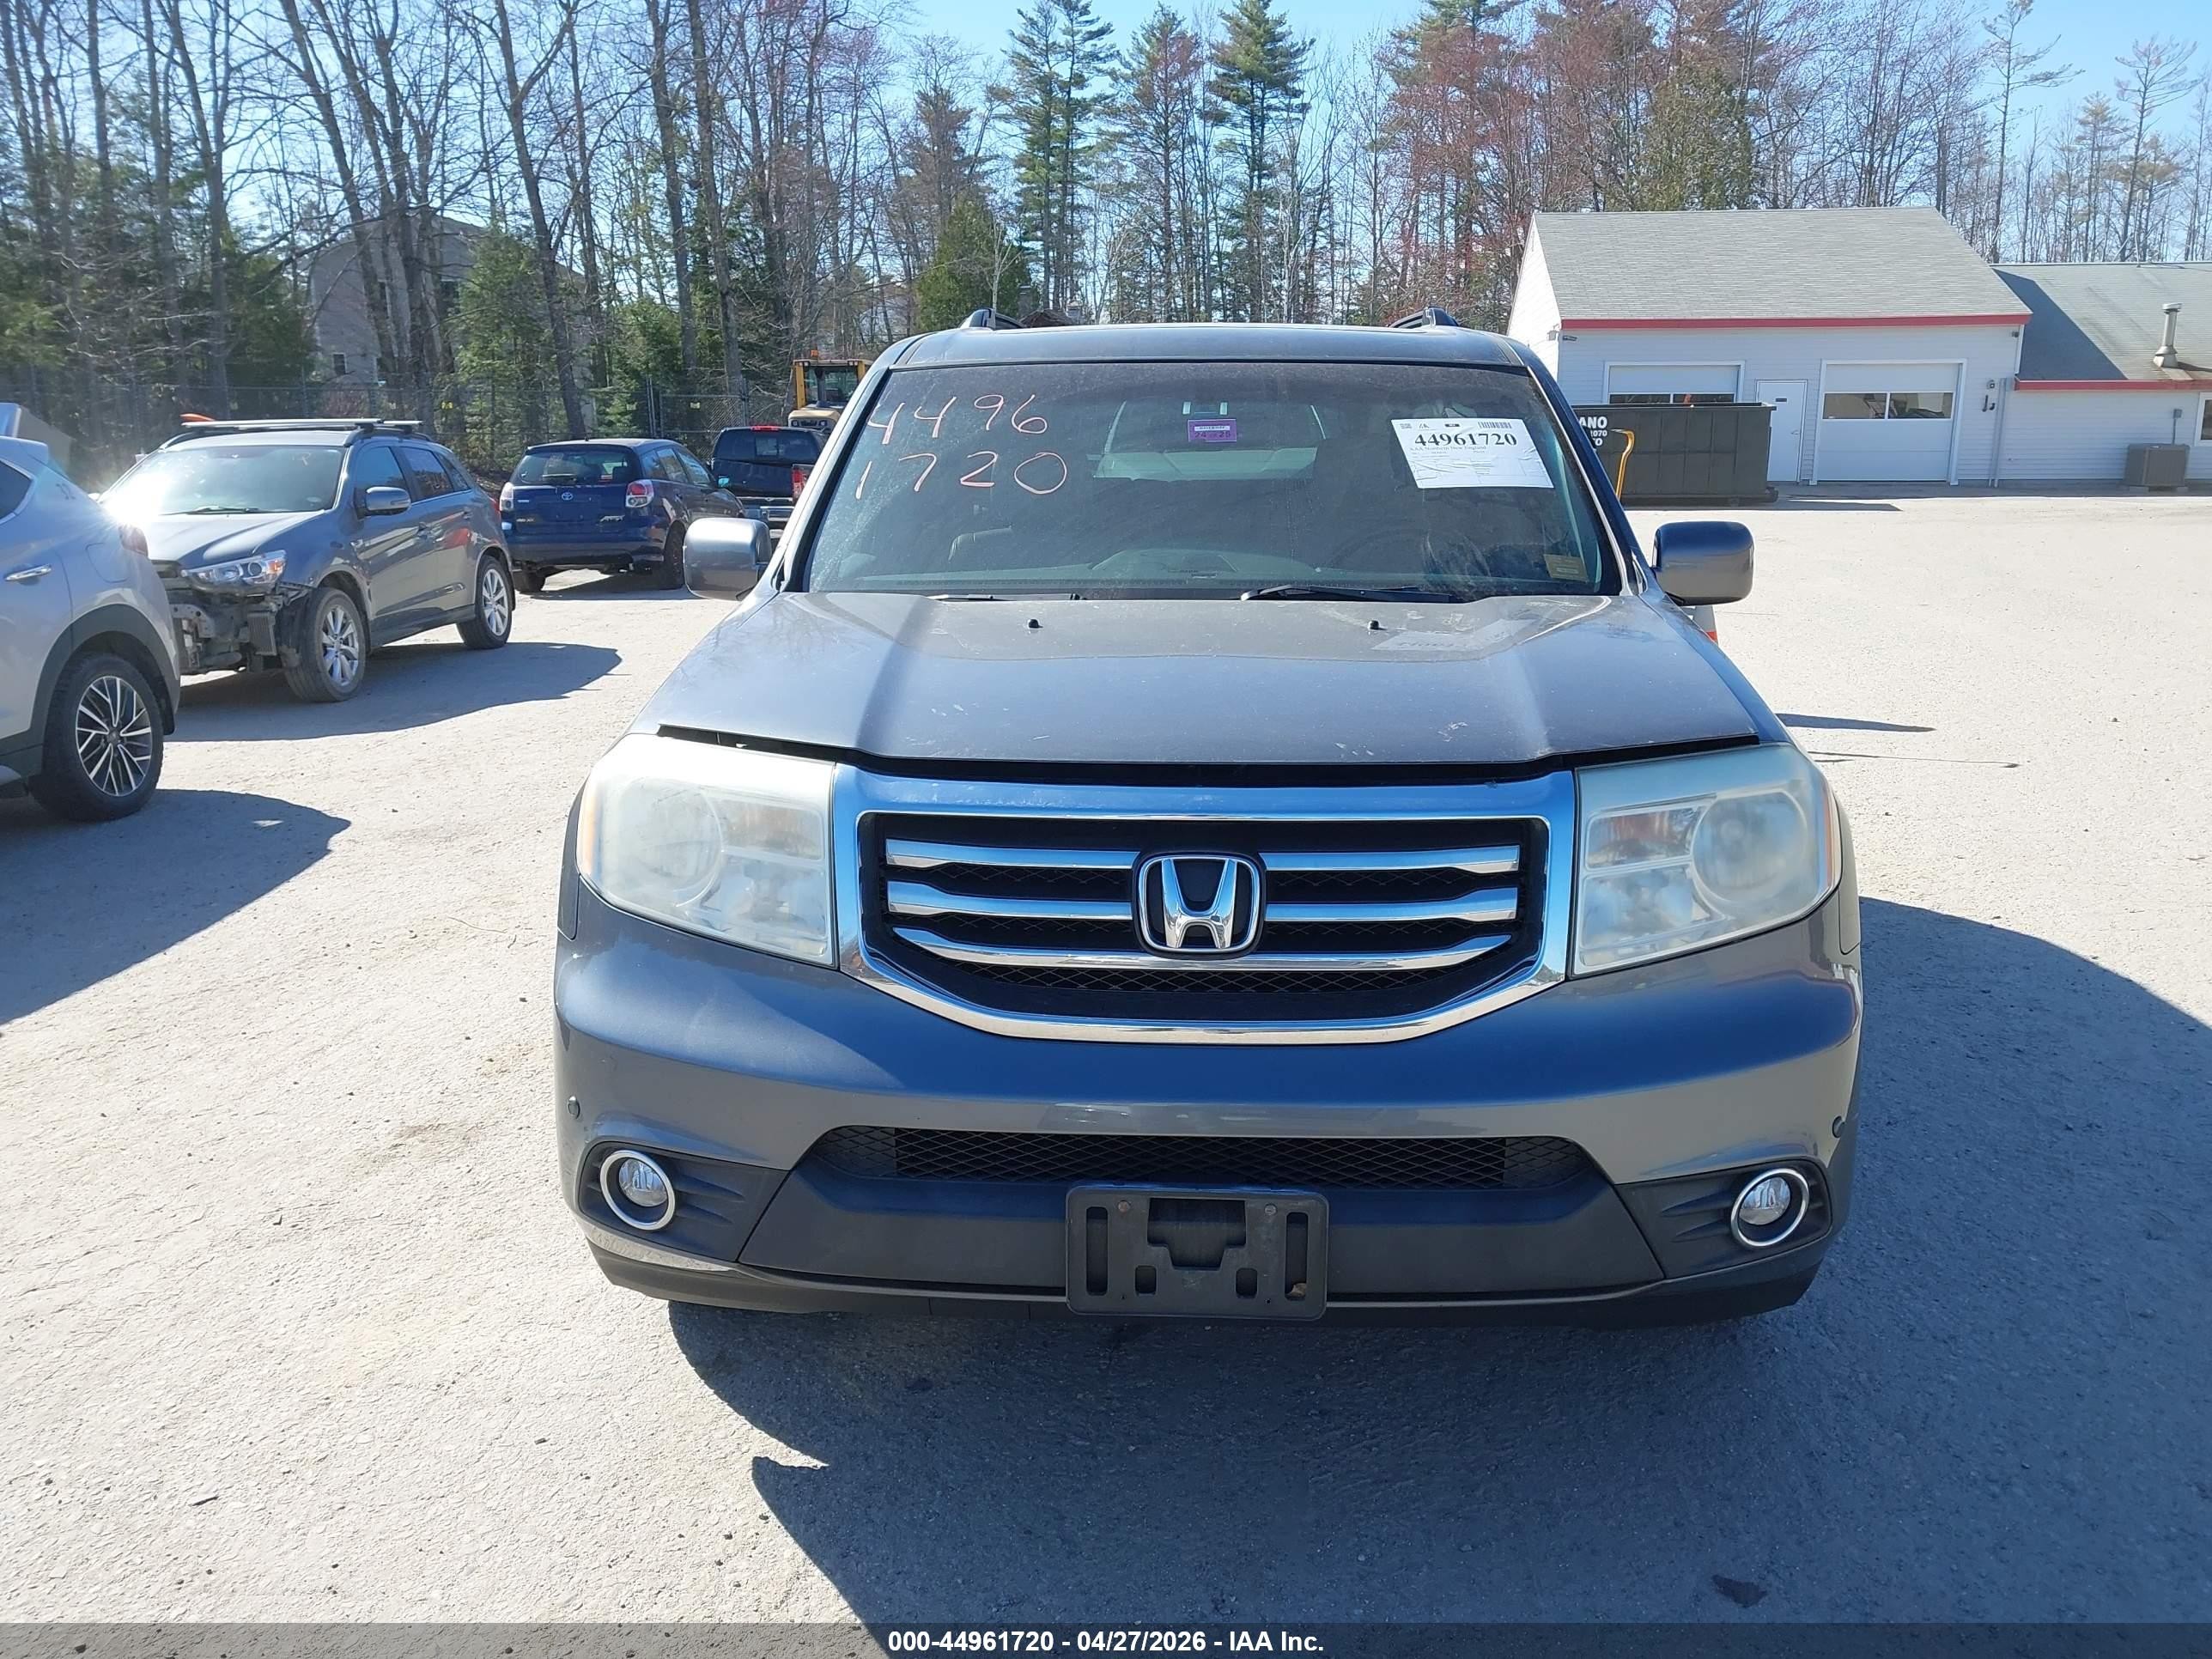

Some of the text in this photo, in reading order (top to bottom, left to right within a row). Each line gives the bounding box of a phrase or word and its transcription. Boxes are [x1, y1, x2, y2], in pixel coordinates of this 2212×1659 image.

[866, 394, 1048, 445] 4496
[1414, 433, 1517, 446] 44961720
[855, 452, 1067, 500] 1720
